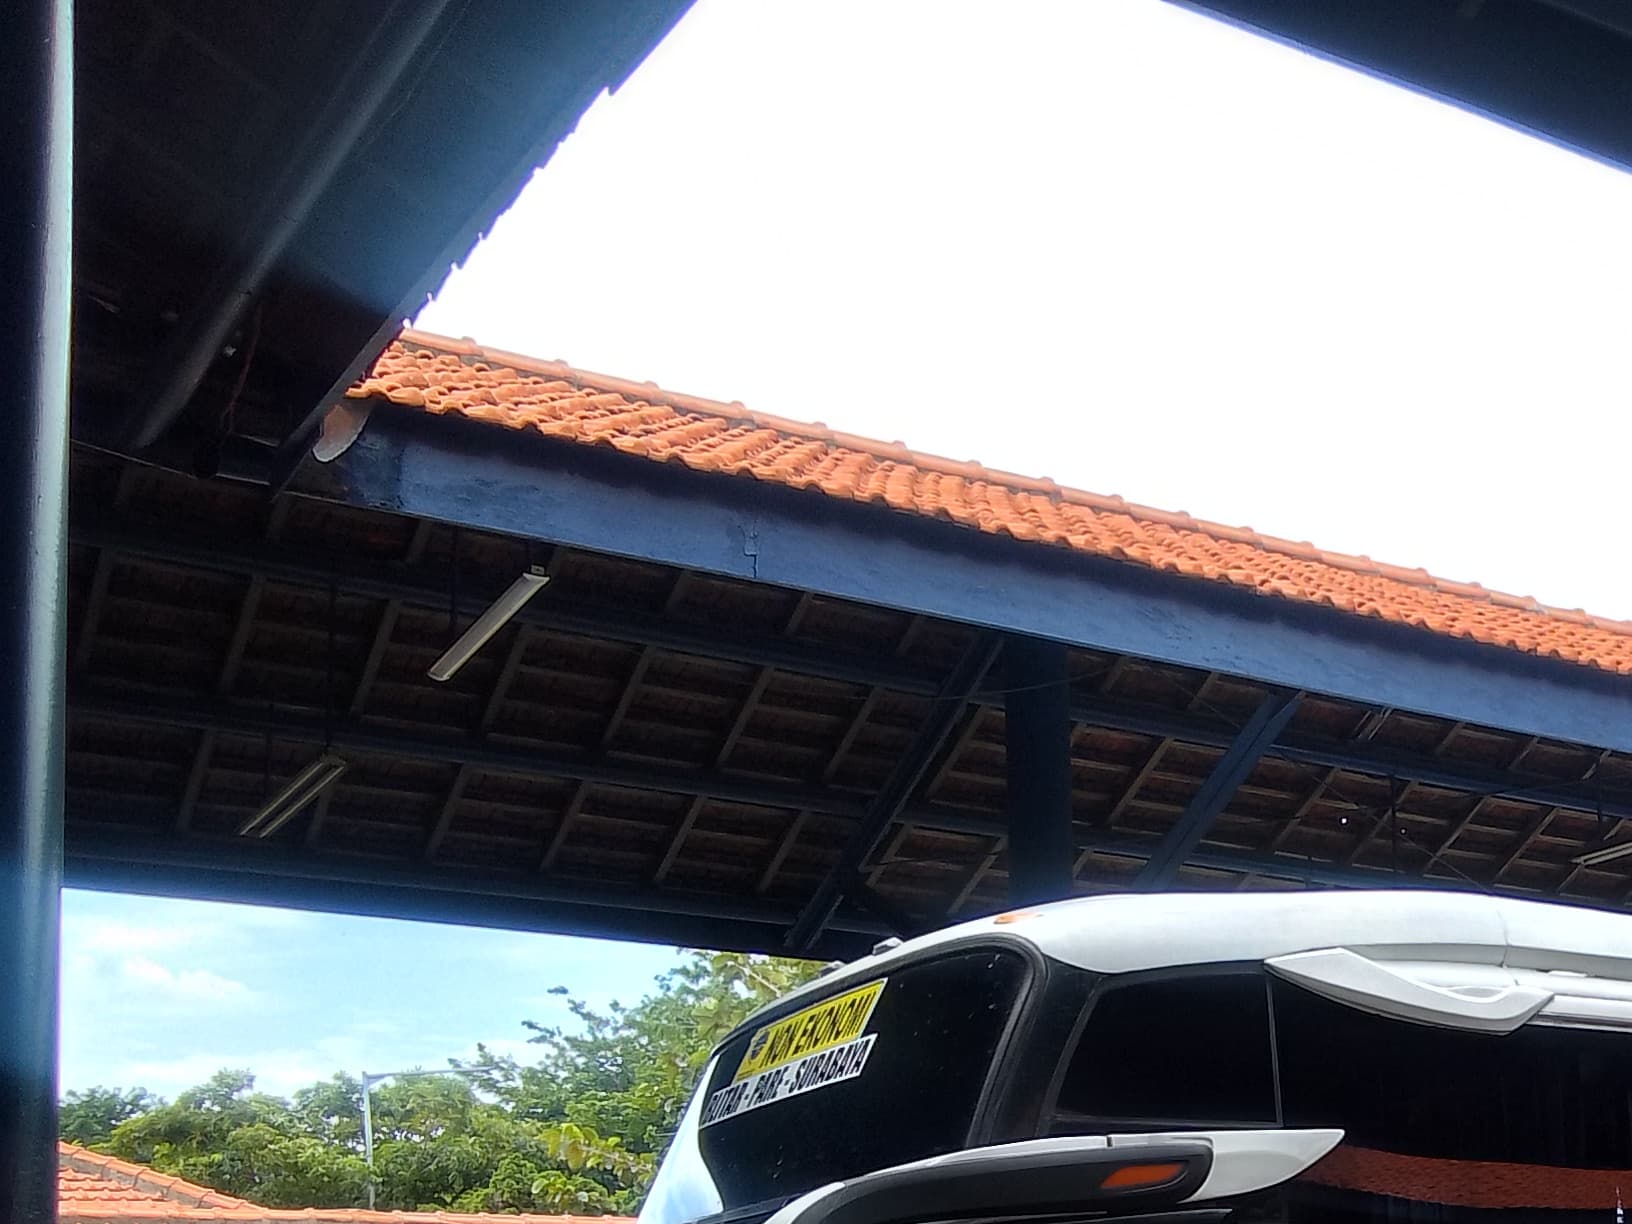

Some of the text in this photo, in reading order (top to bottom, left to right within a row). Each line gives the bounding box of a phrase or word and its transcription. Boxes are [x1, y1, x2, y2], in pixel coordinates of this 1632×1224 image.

[761, 991, 877, 1067] NON EKONOMI
[788, 1039, 872, 1094] SURABAYA
